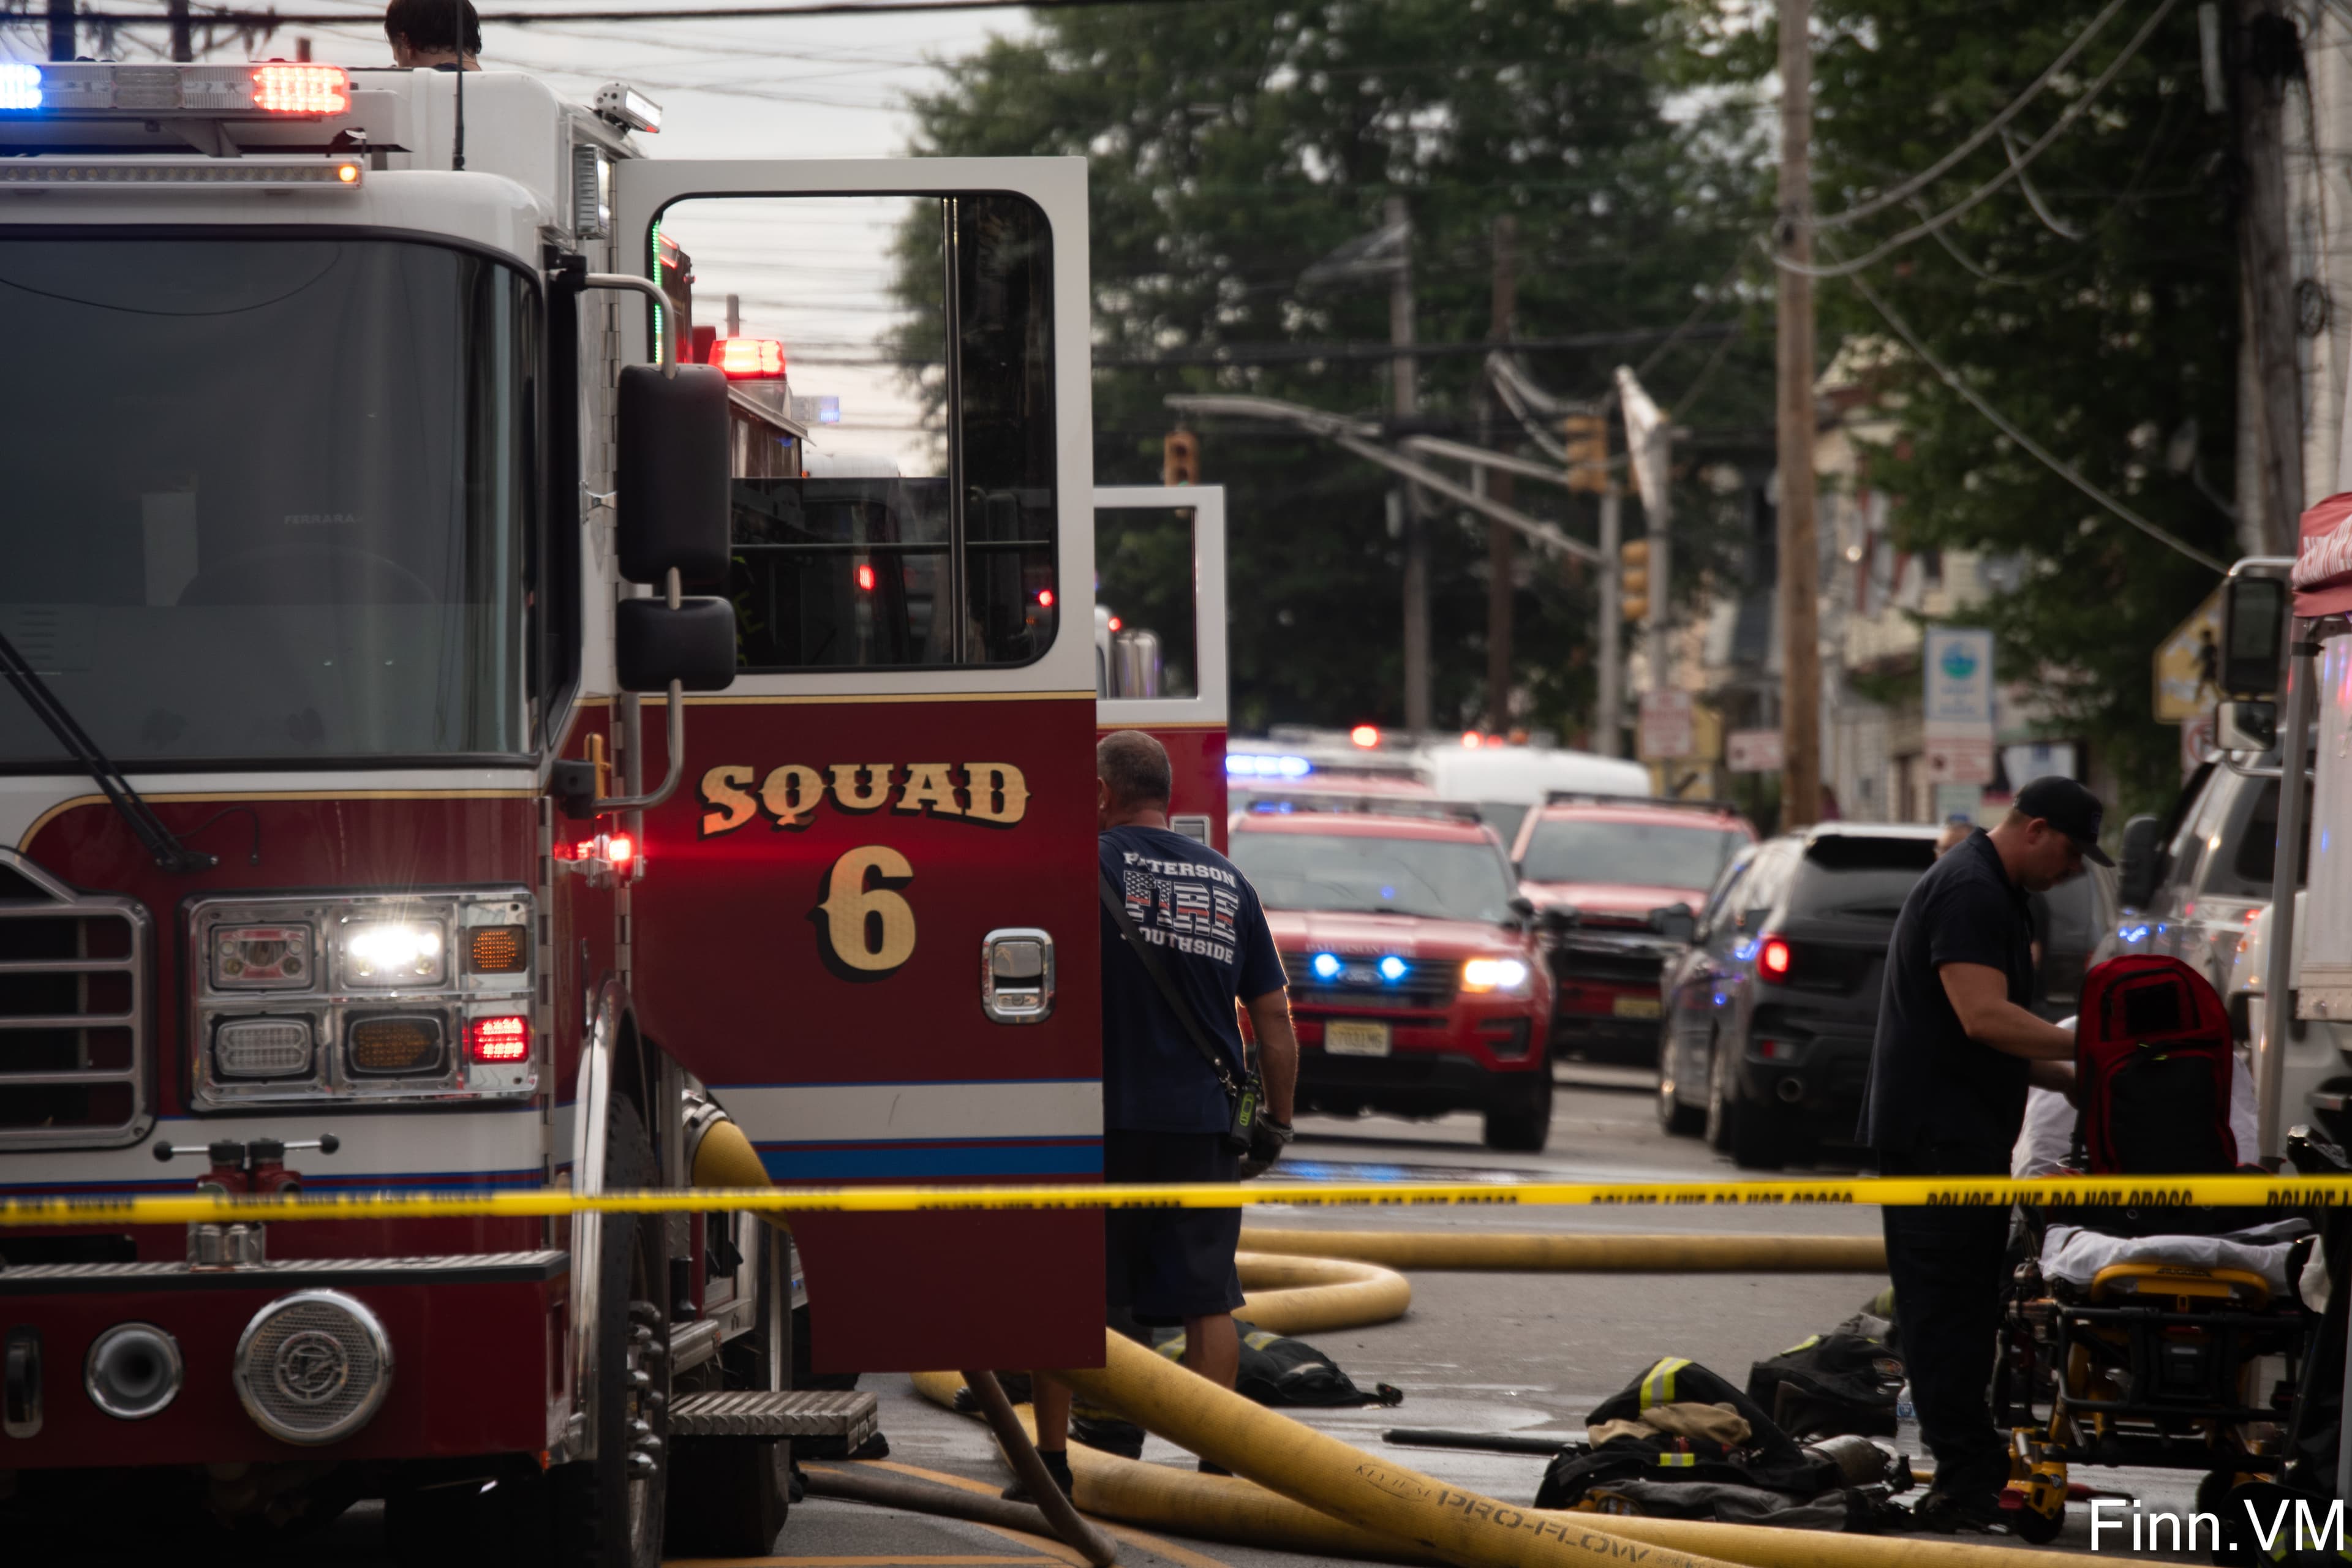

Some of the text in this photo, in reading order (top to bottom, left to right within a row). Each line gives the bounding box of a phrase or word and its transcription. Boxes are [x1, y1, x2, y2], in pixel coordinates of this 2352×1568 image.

[699, 763, 1031, 839] SQUAD
[813, 845, 916, 975] 6
[1120, 927, 1235, 965] OUTHSIDE
[1123, 870, 1239, 946] FIRE
[1435, 1489, 1651, 1563] PRO-FLOW
